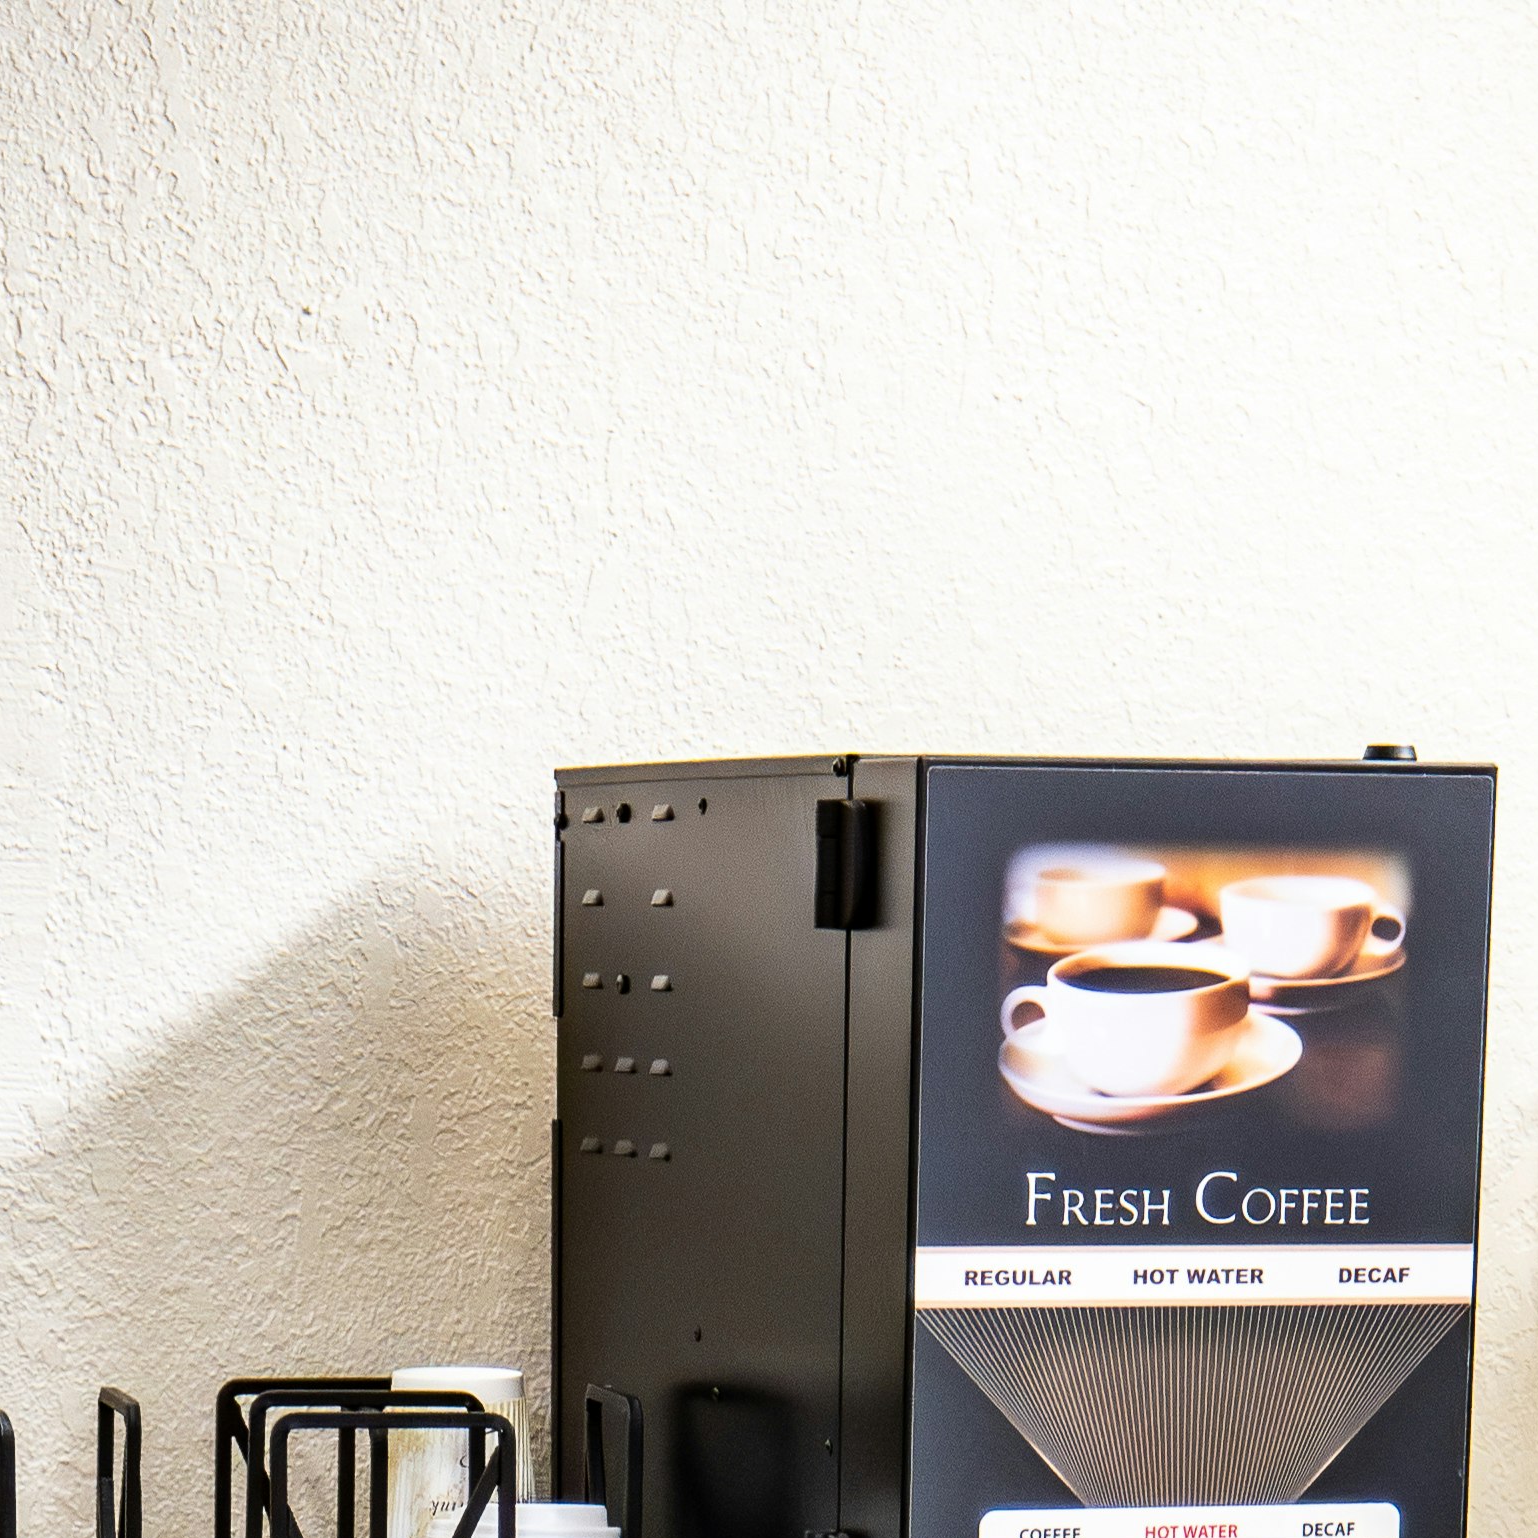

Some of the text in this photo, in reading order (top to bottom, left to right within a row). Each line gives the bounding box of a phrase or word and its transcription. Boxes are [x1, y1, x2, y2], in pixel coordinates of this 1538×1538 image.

[963, 1269, 1073, 1287] REGULAR
[1132, 1267, 1264, 1286] HOT WATER
[1338, 1266, 1411, 1284] DECAF
[1301, 1521, 1355, 1537] DECAF
